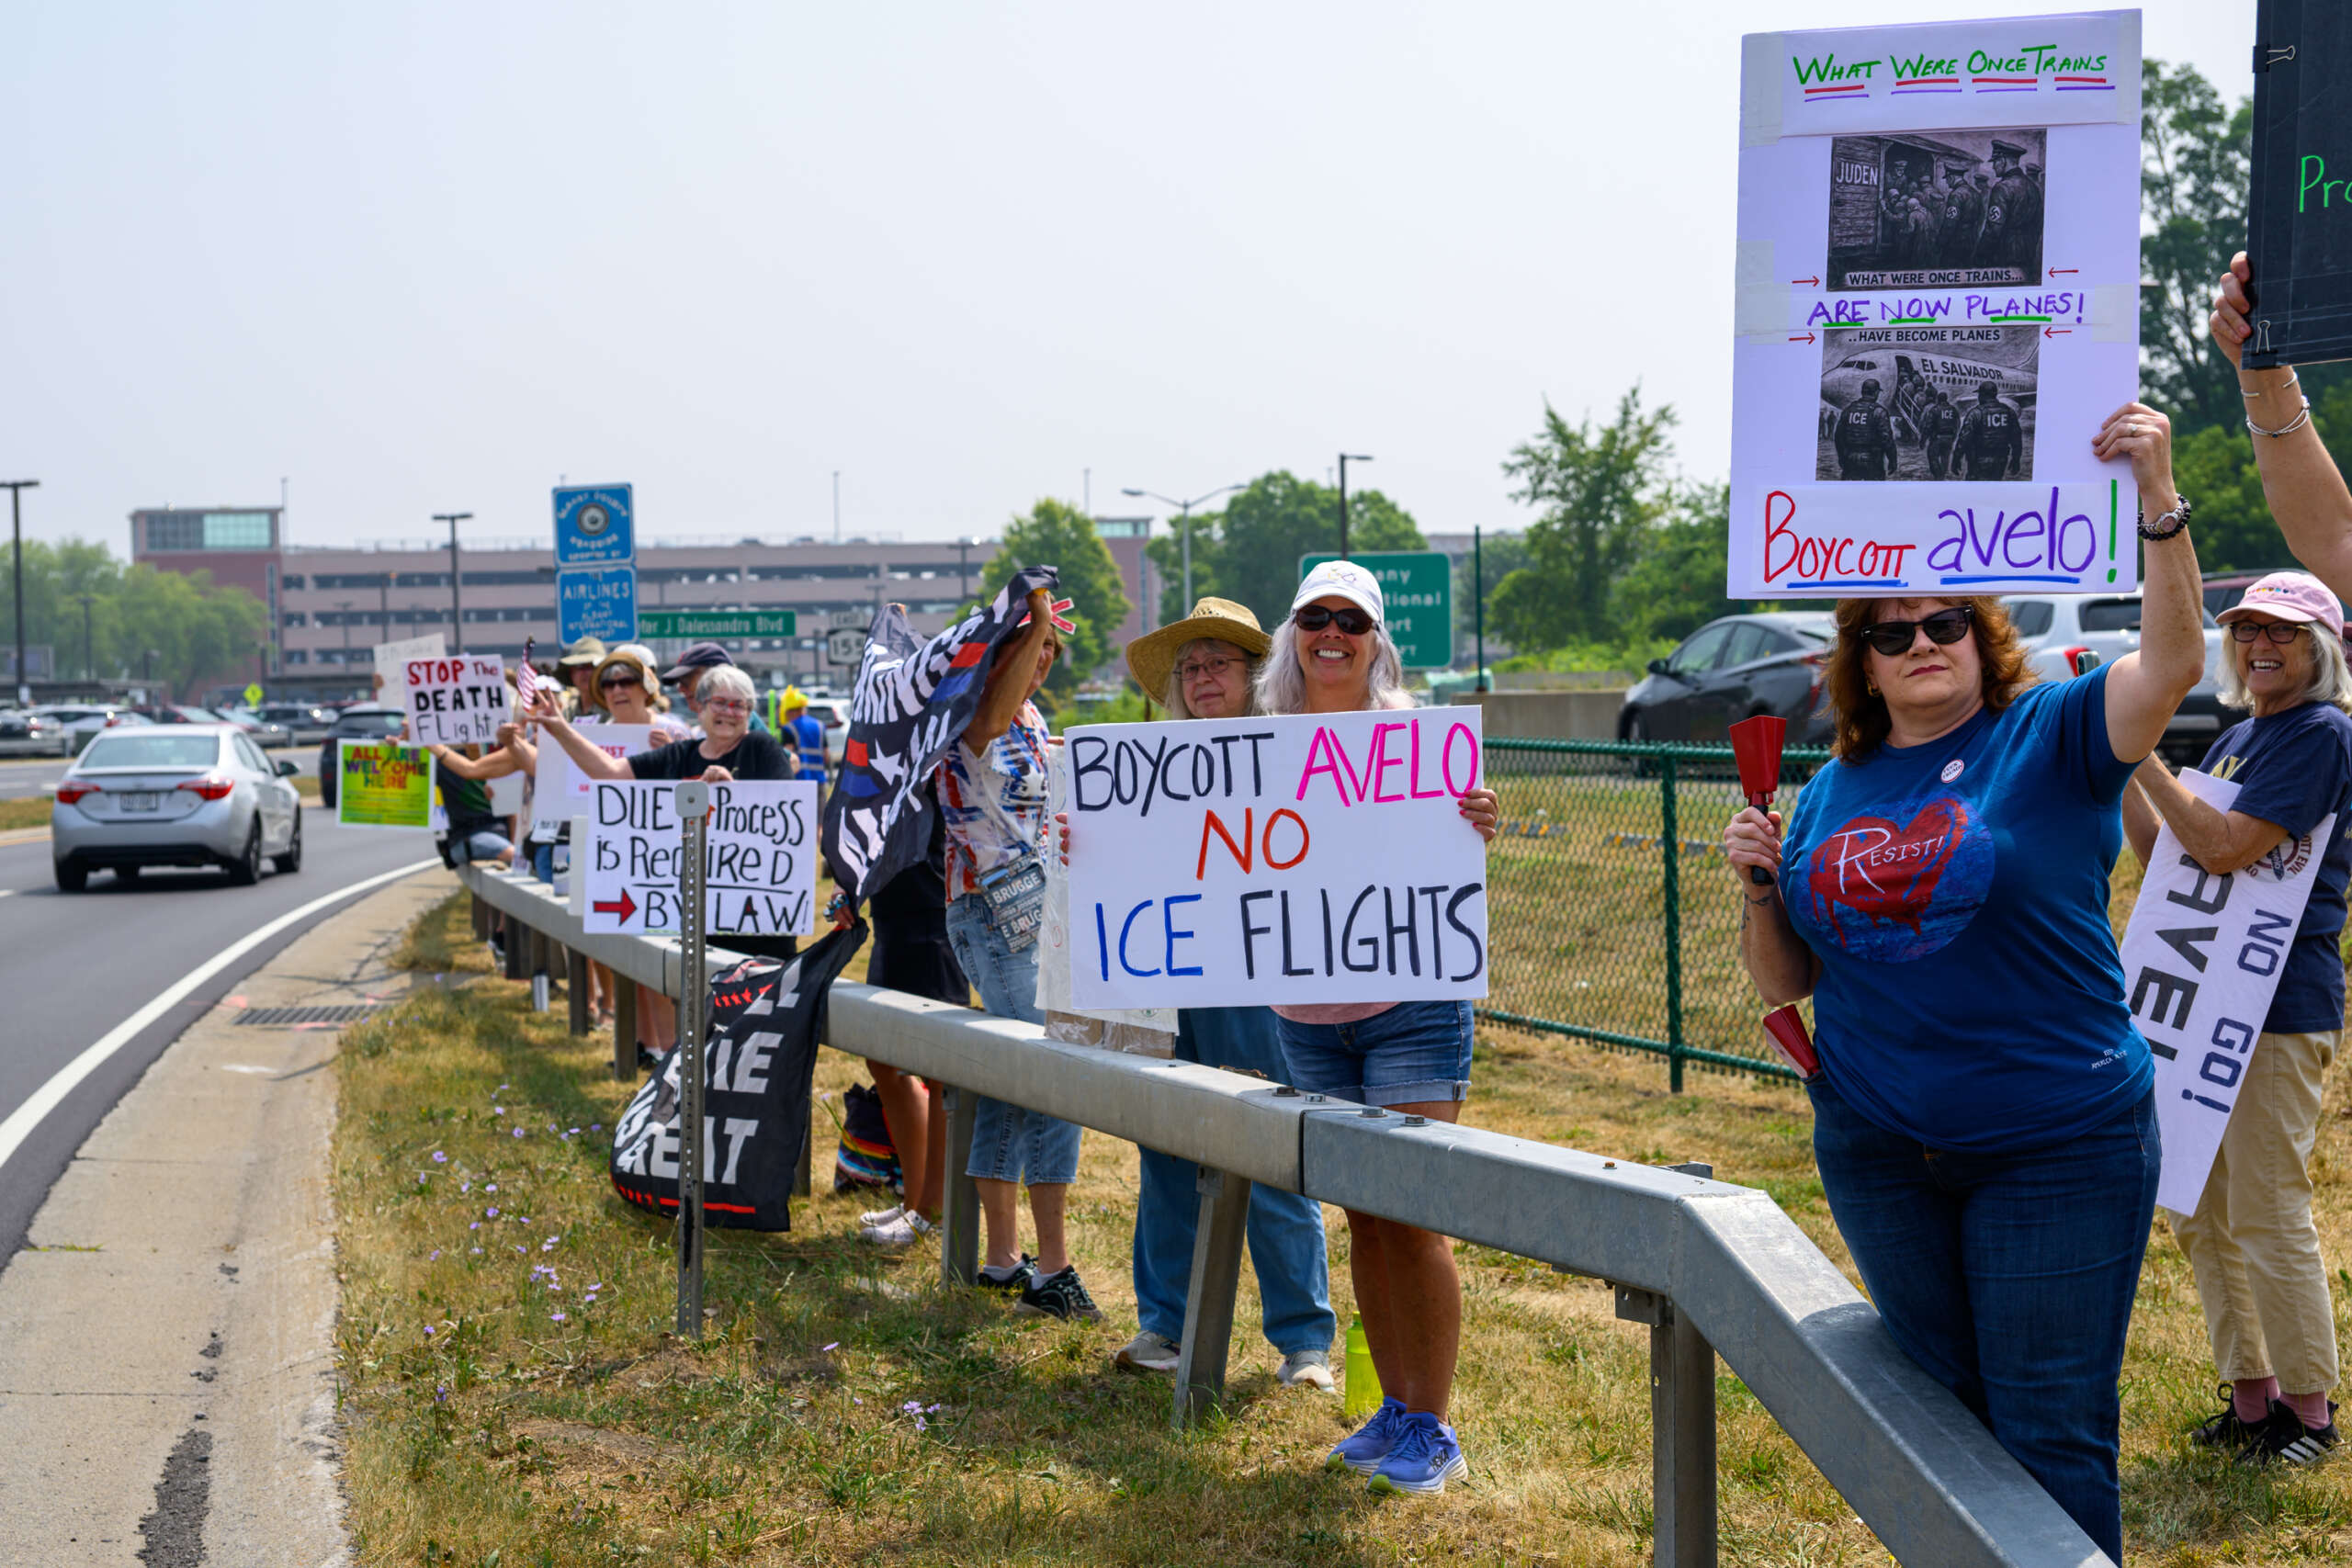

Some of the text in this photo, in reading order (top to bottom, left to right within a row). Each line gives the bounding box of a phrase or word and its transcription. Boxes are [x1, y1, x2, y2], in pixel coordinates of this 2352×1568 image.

[1792, 44, 2108, 85] WHAT WERE ONCE TRAINS
[1836, 161, 1878, 186] JUDEN
[1849, 269, 2023, 286] WHAT WERE ONCE TRAINS...
[1806, 292, 2085, 326] ARE NOW PLANES!
[1895, 330, 1948, 343] BECOME
[1951, 329, 2000, 341] PLANES
[1921, 357, 2004, 381] EL SALVADOR
[1849, 412, 1867, 425] ICE
[1940, 410, 1953, 420] ICE
[1986, 413, 2007, 427] ICE
[563, 581, 630, 600] AIRLINES
[664, 618, 673, 634] J
[677, 617, 751, 634] Dalessandro
[755, 616, 784, 633] Blvd
[407, 660, 465, 685] STOP
[414, 685, 504, 712] DEATH
[352, 746, 382, 761] ALL
[345, 760, 428, 777] WELCOME
[1070, 718, 1479, 817] BOYCOTT AVELO
[364, 774, 407, 790] HERE
[597, 784, 805, 847] DUE Process
[596, 834, 621, 872] is
[1195, 807, 1310, 882] NO
[1831, 827, 1945, 895] RESIST!
[2286, 855, 2309, 875] EVIL
[992, 872, 1040, 905] BRUGGE
[1094, 882, 1484, 984] ICE FLIGHTS
[2181, 908, 2293, 1114] NO GO!
